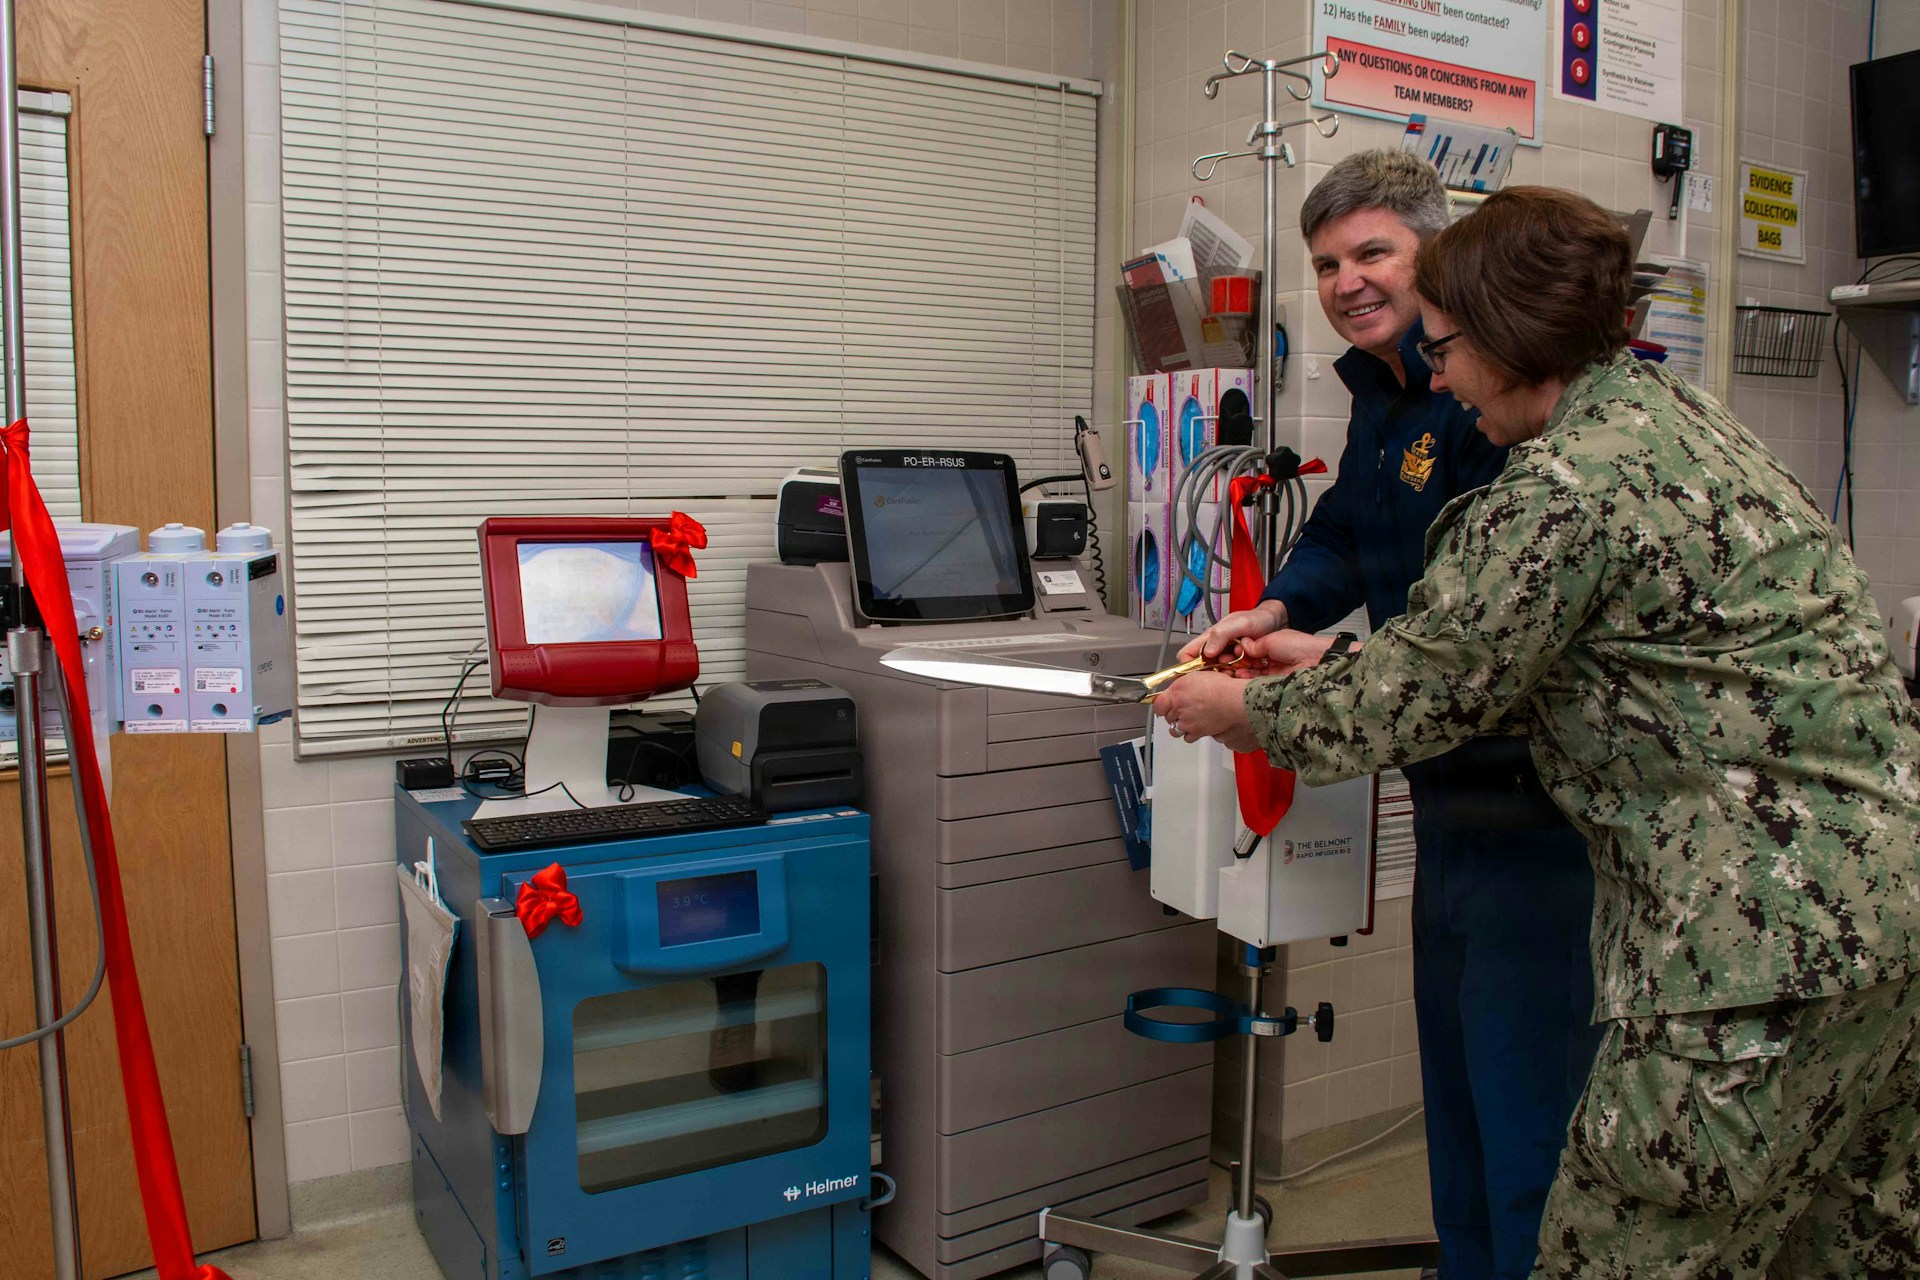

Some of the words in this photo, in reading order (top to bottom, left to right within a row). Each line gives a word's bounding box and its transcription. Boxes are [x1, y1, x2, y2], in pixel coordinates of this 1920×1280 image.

[1323, 2, 1337, 20] 12)
[1339, 6, 1356, 21] Has
[1358, 11, 1372, 25] the
[1374, 15, 1406, 33] FAMILY
[1408, 23, 1428, 38] been
[1430, 29, 1469, 47] updated?
[1421, 0, 1441, 13] UNIT
[1443, 3, 1463, 19] been
[1465, 10, 1510, 30] contacted?
[1337, 47, 1357, 64] ANY
[1360, 52, 1413, 78] QUESTIONS
[1415, 65, 1428, 79] OR
[1430, 68, 1478, 90] CONCERNS
[1480, 78, 1507, 96] FROM
[1508, 84, 1528, 100] ANY
[1393, 85, 1421, 106] TEAM
[1423, 91, 1473, 112] MEMBERS?
[1749, 173, 1793, 196] EVIDENCE
[1743, 199, 1797, 223] COLLECTION
[1757, 228, 1782, 246] BAGS
[903, 456, 965, 468] PO-ER-RSUS
[1296, 851, 1314, 859] RAPID
[1315, 849, 1338, 857] INFUSER
[1297, 841, 1312, 850] THE
[805, 1174, 859, 1197] Helmer
